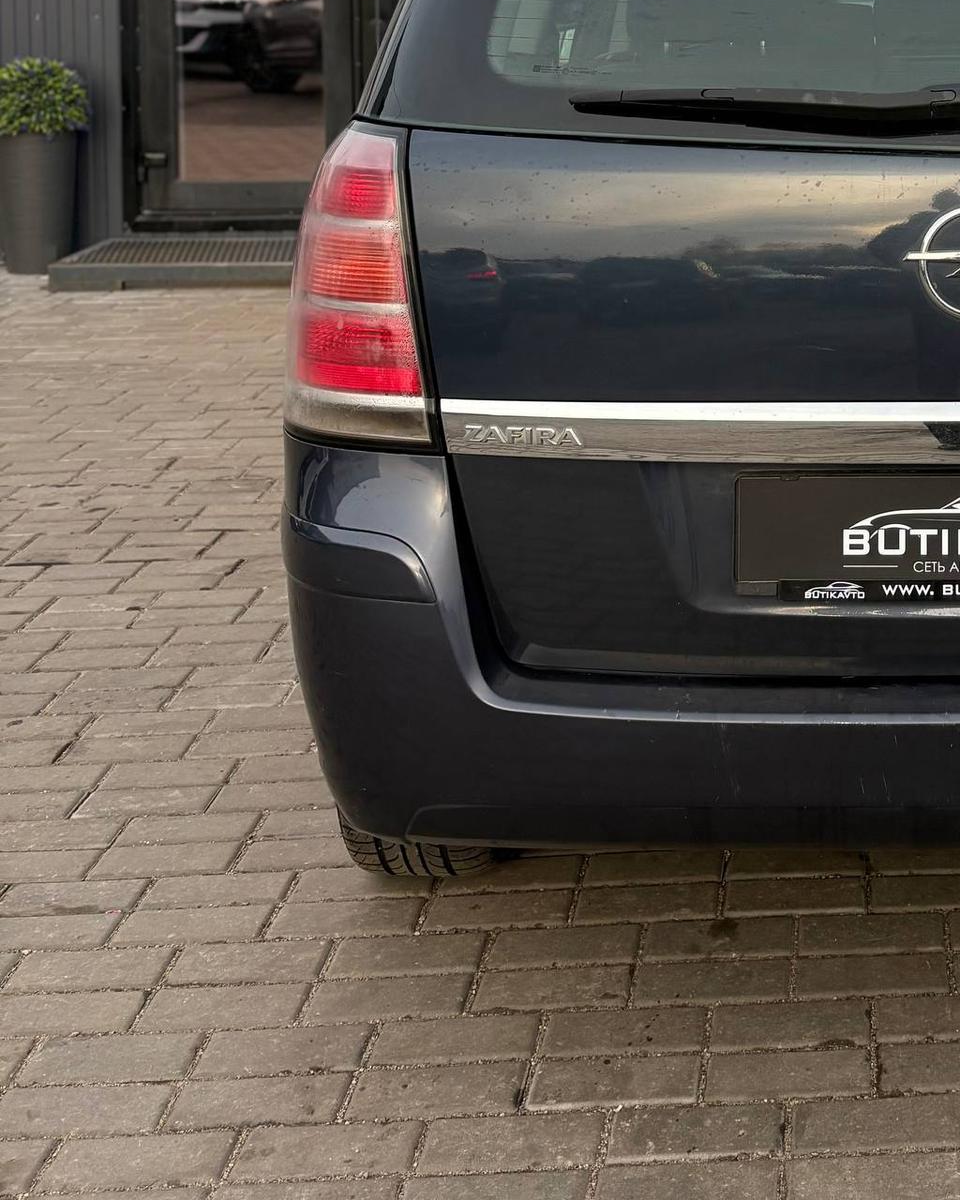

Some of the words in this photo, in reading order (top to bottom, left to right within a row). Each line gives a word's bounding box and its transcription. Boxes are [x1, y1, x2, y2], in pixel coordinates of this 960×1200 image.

[464, 424, 583, 447] ZAFIRA
[913, 560, 946, 573] СЕТЬ
[804, 590, 866, 600] BUTIKAVTO
[882, 583, 935, 597] WWW.
